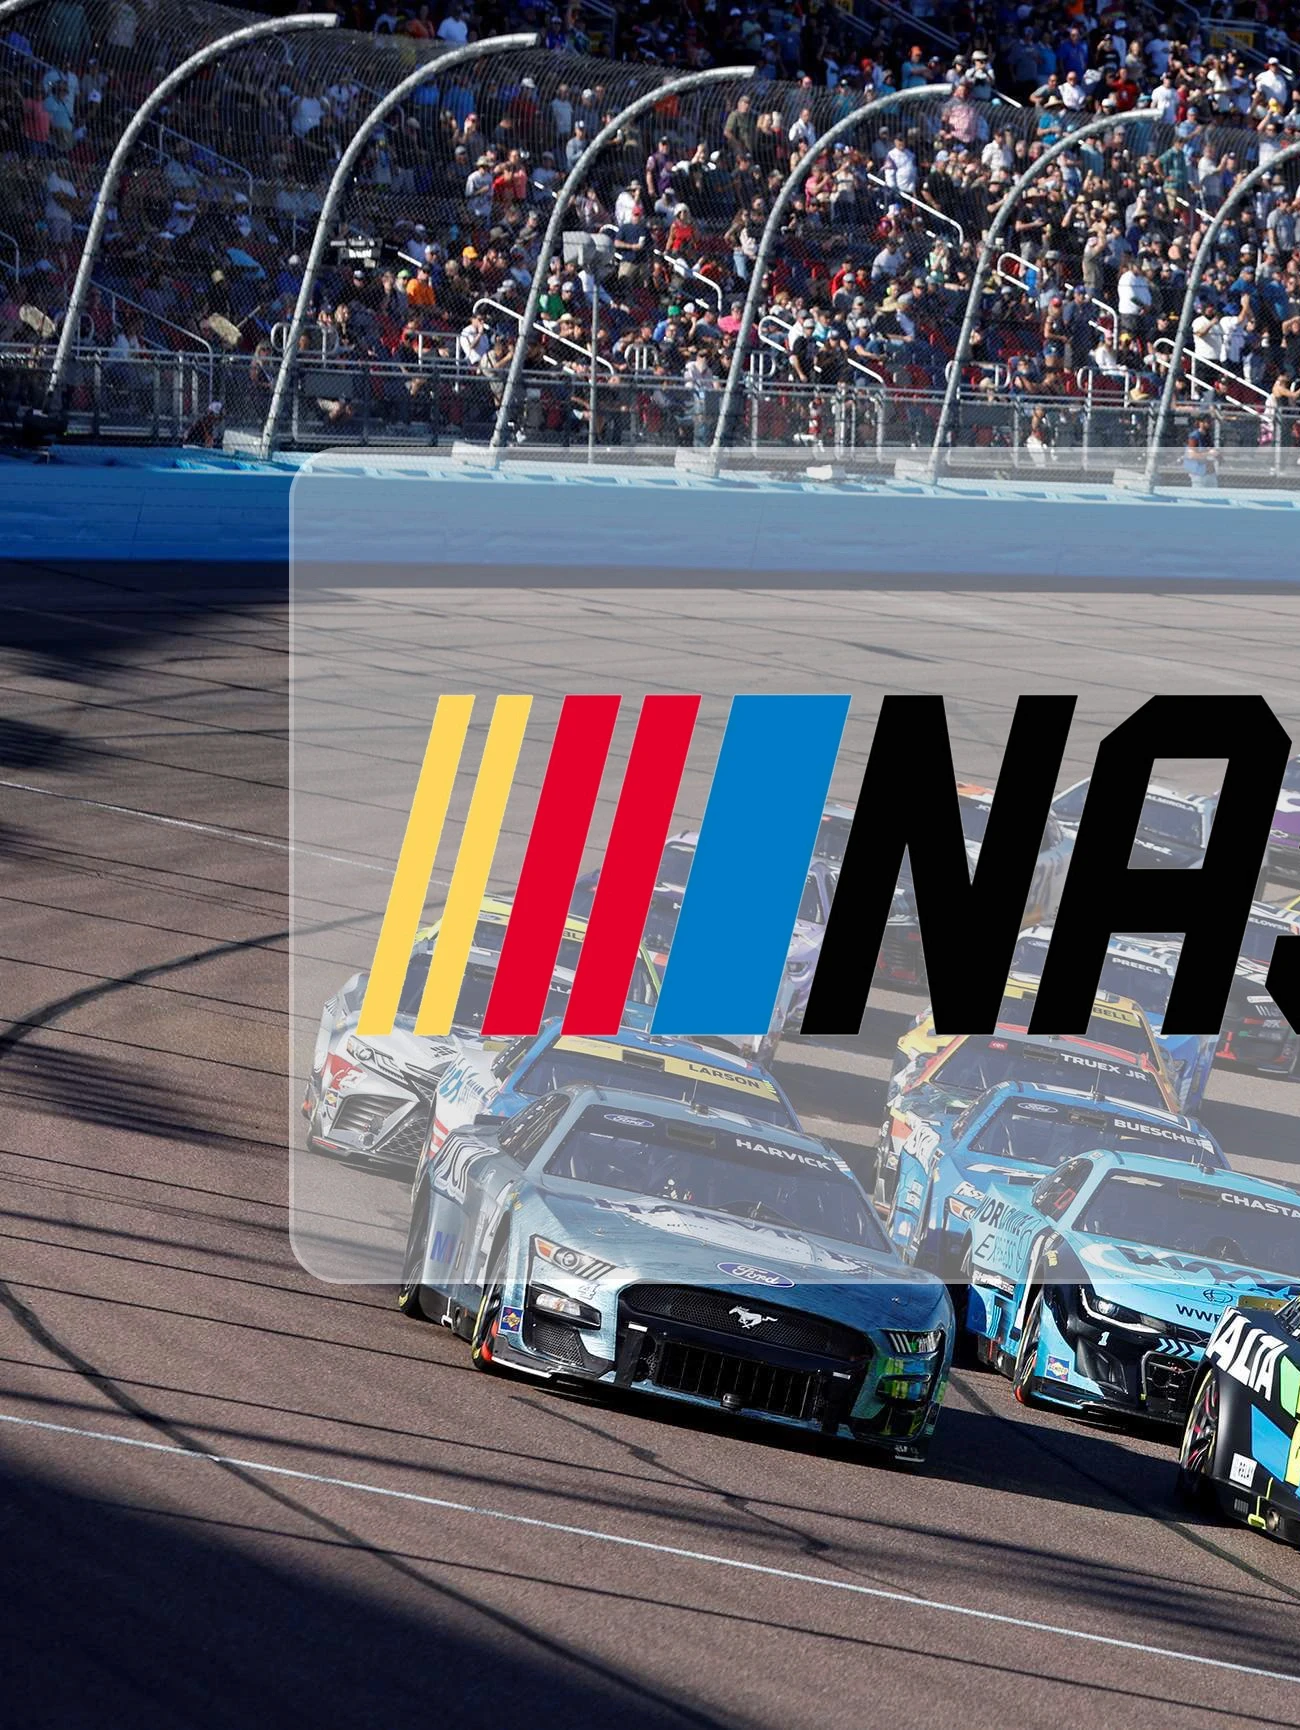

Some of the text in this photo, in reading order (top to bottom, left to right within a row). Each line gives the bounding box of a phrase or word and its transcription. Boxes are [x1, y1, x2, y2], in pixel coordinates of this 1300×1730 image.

[1112, 957, 1161, 975] PREECE
[688, 1063, 761, 1090] LARSON
[1060, 1053, 1148, 1082] TRUEX JR
[735, 1137, 833, 1173] HARVICK
[1097, 1332, 1109, 1347] 1
[1204, 1306, 1290, 1402] ALTA
